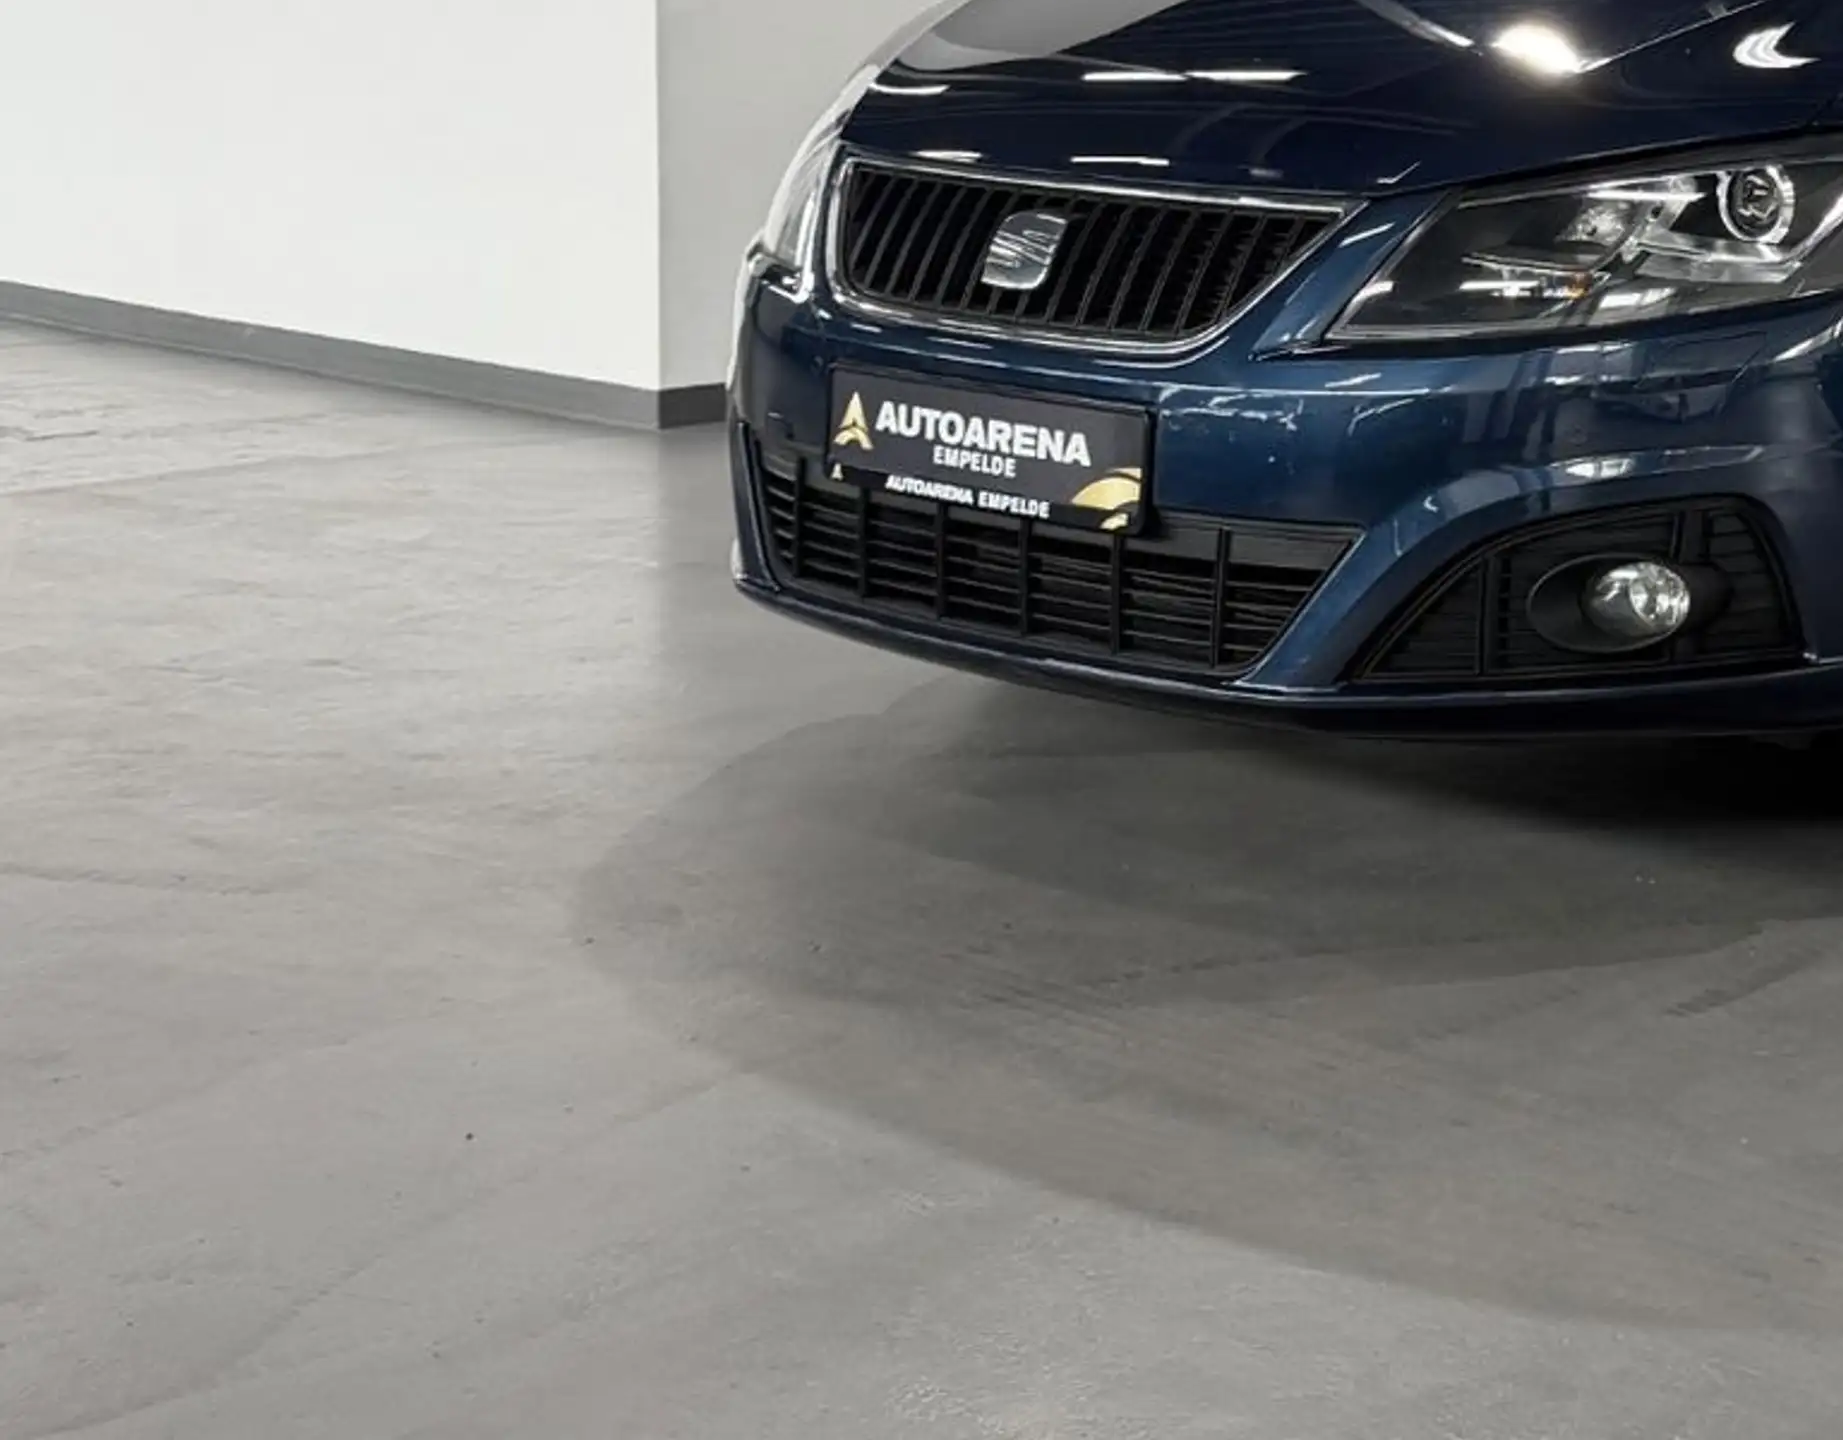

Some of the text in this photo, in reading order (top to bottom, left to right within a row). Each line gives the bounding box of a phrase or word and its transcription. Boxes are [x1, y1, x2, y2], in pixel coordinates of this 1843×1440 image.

[875, 400, 1092, 467] AUTOARENA
[932, 444, 1017, 479] EMPELDE
[885, 474, 1051, 520] AUTOARENA EMPELDE
